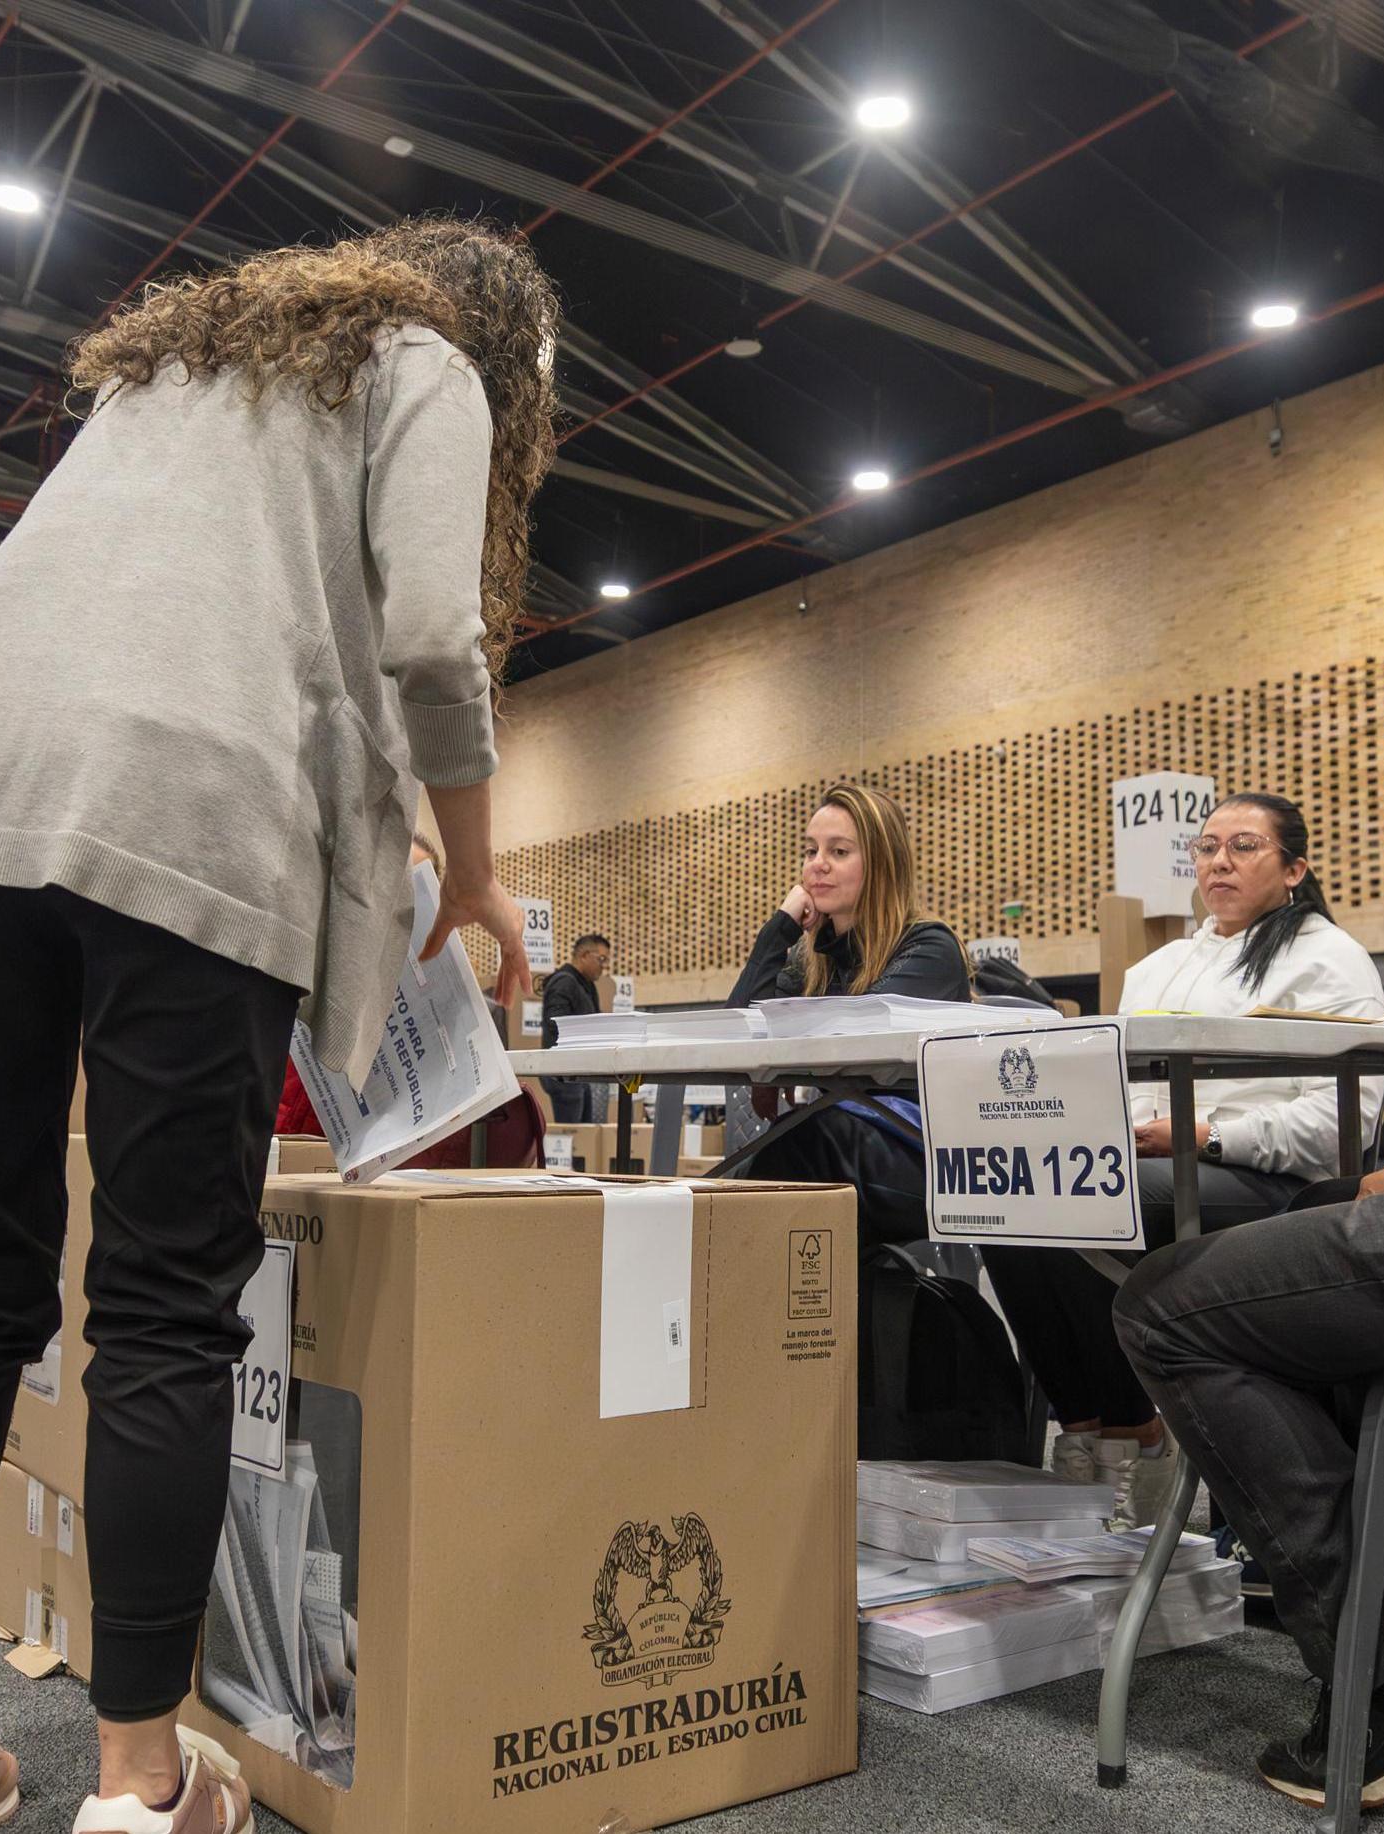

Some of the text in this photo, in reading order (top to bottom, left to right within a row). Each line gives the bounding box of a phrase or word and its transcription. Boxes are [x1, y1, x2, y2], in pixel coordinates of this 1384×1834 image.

[1117, 788, 1164, 829] 124
[1169, 789, 1211, 824] 124
[527, 909, 550, 931] 33
[619, 983, 632, 997] 43
[403, 1016, 425, 1060] PARA
[379, 1053, 400, 1100] NACIONAL
[394, 1038, 424, 1126] REPÚBLICA
[978, 1097, 1065, 1113] REGISTRADURÍA
[979, 1110, 1065, 1120] NACIONAL DEL ESTADO CIVIL
[935, 1145, 1126, 1198] MESA 123
[261, 1211, 324, 1245] ENADO
[801, 1261, 821, 1270] FSC
[781, 1338, 837, 1351] manejo forestal
[786, 1327, 833, 1339] La marca del
[786, 1350, 832, 1362] responsable
[236, 1362, 283, 1425] 123
[639, 1612, 681, 1631] REPÚBLICA
[655, 1625, 665, 1634] DE
[639, 1635, 680, 1653] COLOMBIA
[604, 1651, 713, 1683] ORGANIZACIÓN ELECTORAL
[492, 1662, 808, 1771] REGISTRADURÍA
[492, 1706, 808, 1799] NACIONAL DEL ESTADO CIVIL
